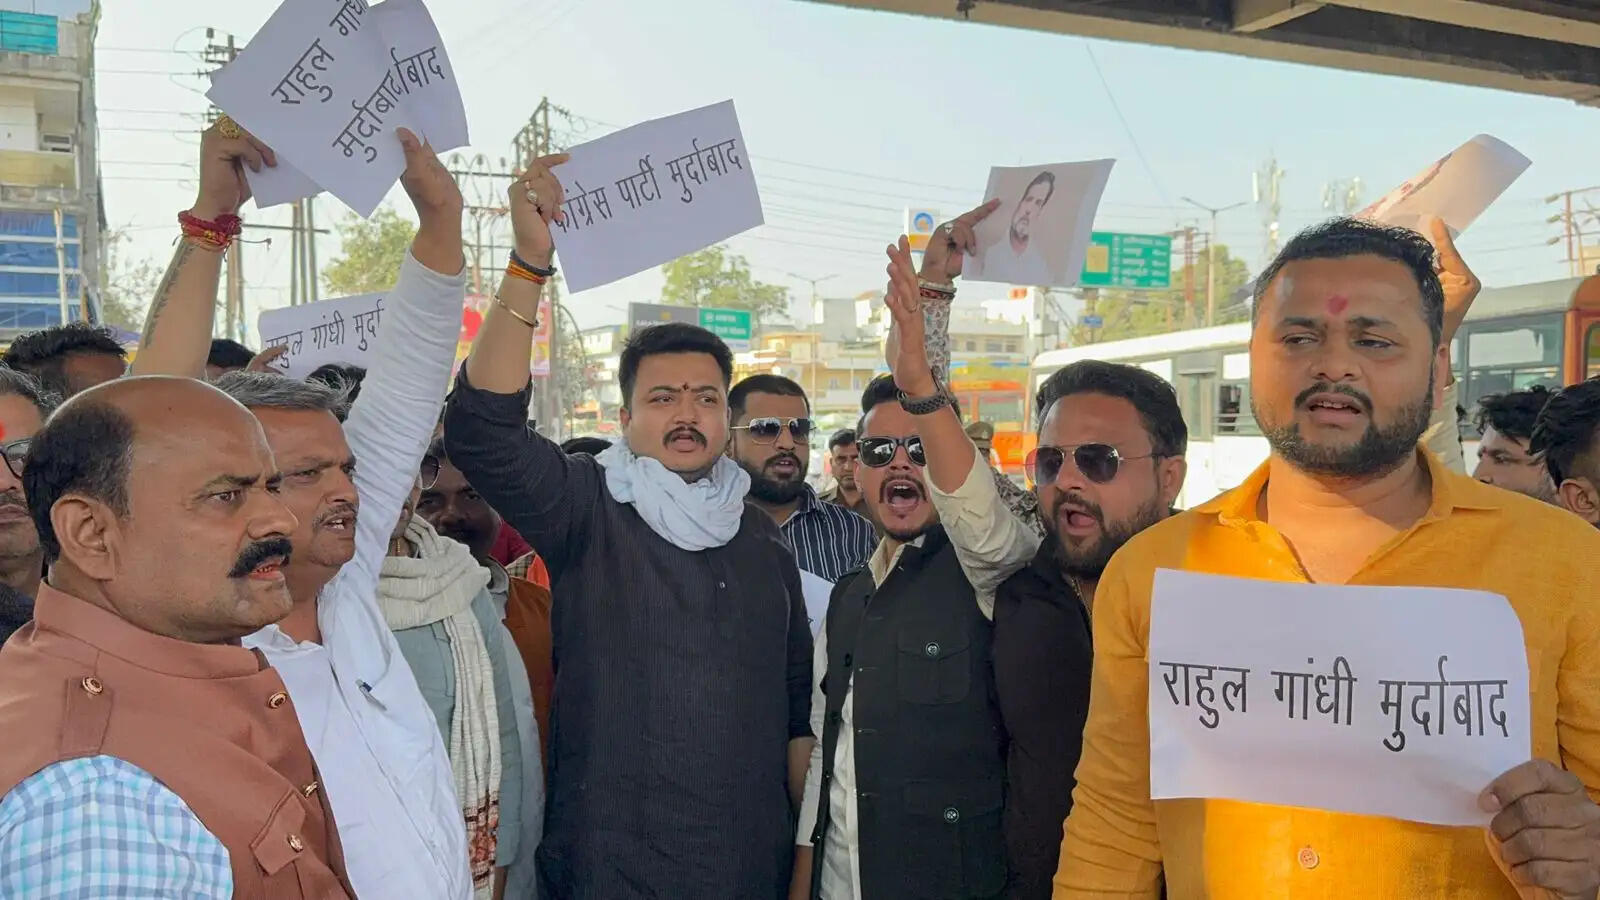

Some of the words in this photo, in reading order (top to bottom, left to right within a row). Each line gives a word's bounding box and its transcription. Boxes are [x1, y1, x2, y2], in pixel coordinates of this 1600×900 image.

[271, 38, 334, 104] राहुल
[615, 155, 662, 209] पार्टी
[665, 138, 743, 204] मुर्दाबाद
[310, 310, 344, 349] गांधी
[1159, 662, 1250, 729] राहुल
[1271, 656, 1357, 725] गांधी
[1378, 655, 1508, 752] मुर्दाबाद
